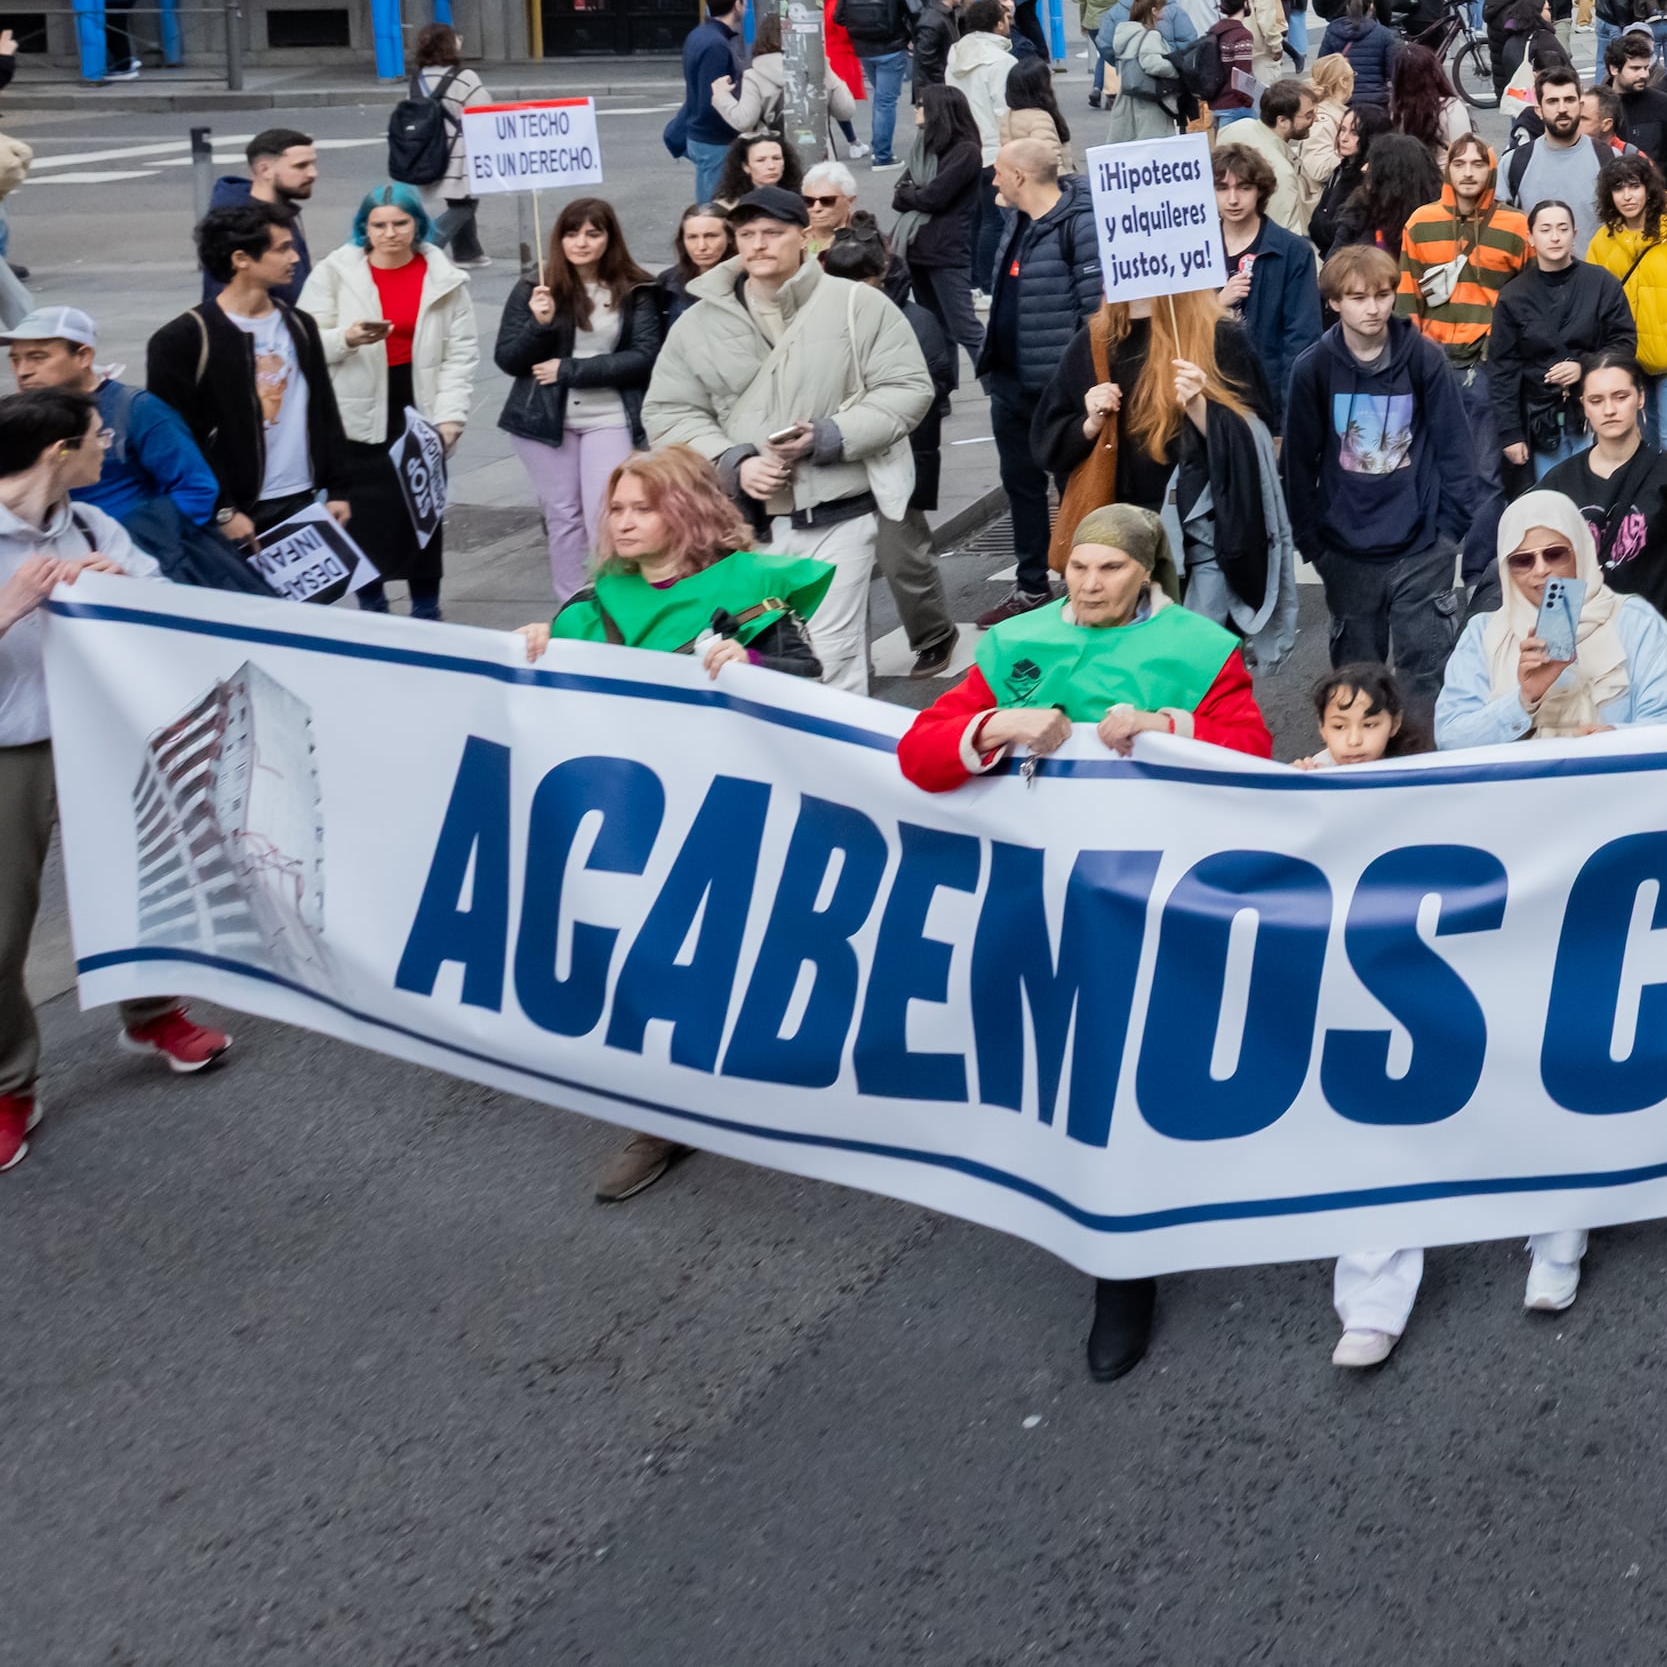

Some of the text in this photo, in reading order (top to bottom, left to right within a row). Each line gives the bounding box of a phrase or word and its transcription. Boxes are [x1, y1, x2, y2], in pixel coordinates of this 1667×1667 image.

[495, 111, 570, 140] UN TECHO
[474, 146, 598, 179] ES UN DERECHO.
[1099, 158, 1202, 194] ¡Hipotecas
[1105, 200, 1207, 243] y alquileres
[1111, 239, 1213, 287] justos, ya!
[407, 457, 431, 519] STOP
[395, 736, 1508, 1148] ACABEMOS
